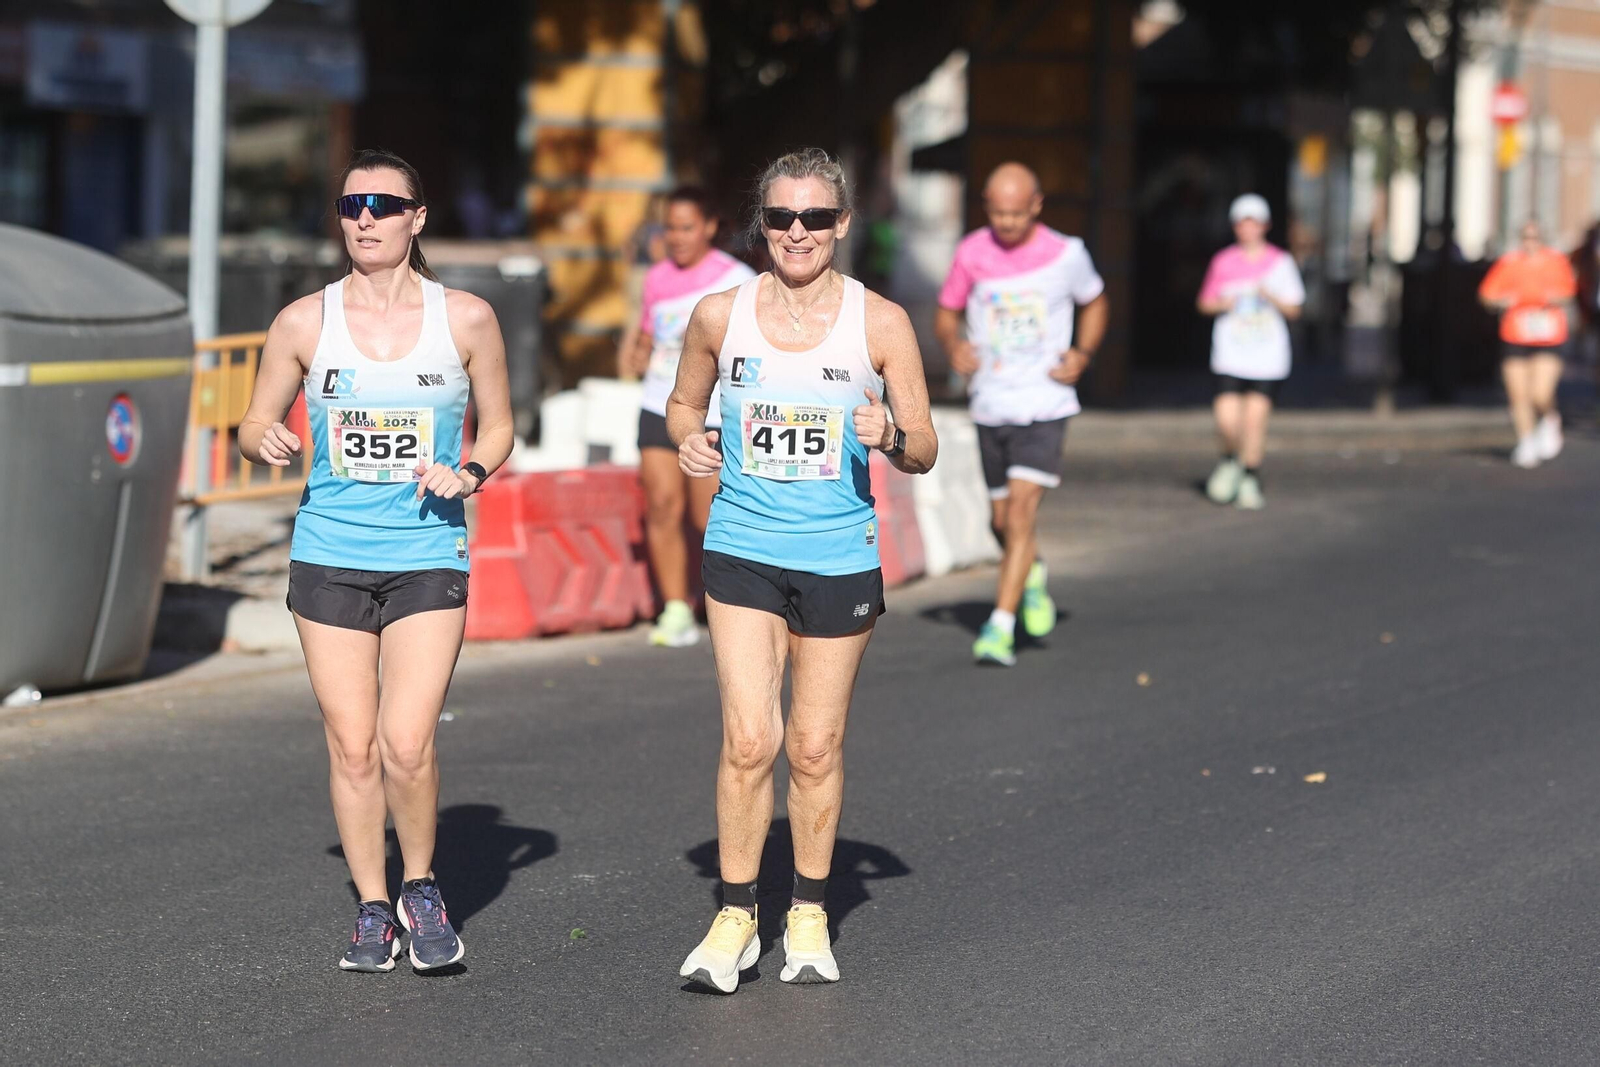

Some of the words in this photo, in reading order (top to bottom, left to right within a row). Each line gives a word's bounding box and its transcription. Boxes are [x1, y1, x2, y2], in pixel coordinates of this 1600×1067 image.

[383, 418, 417, 427] 2025
[793, 413, 827, 423] 2025
[344, 432, 418, 460] 352
[752, 427, 826, 456] 415
